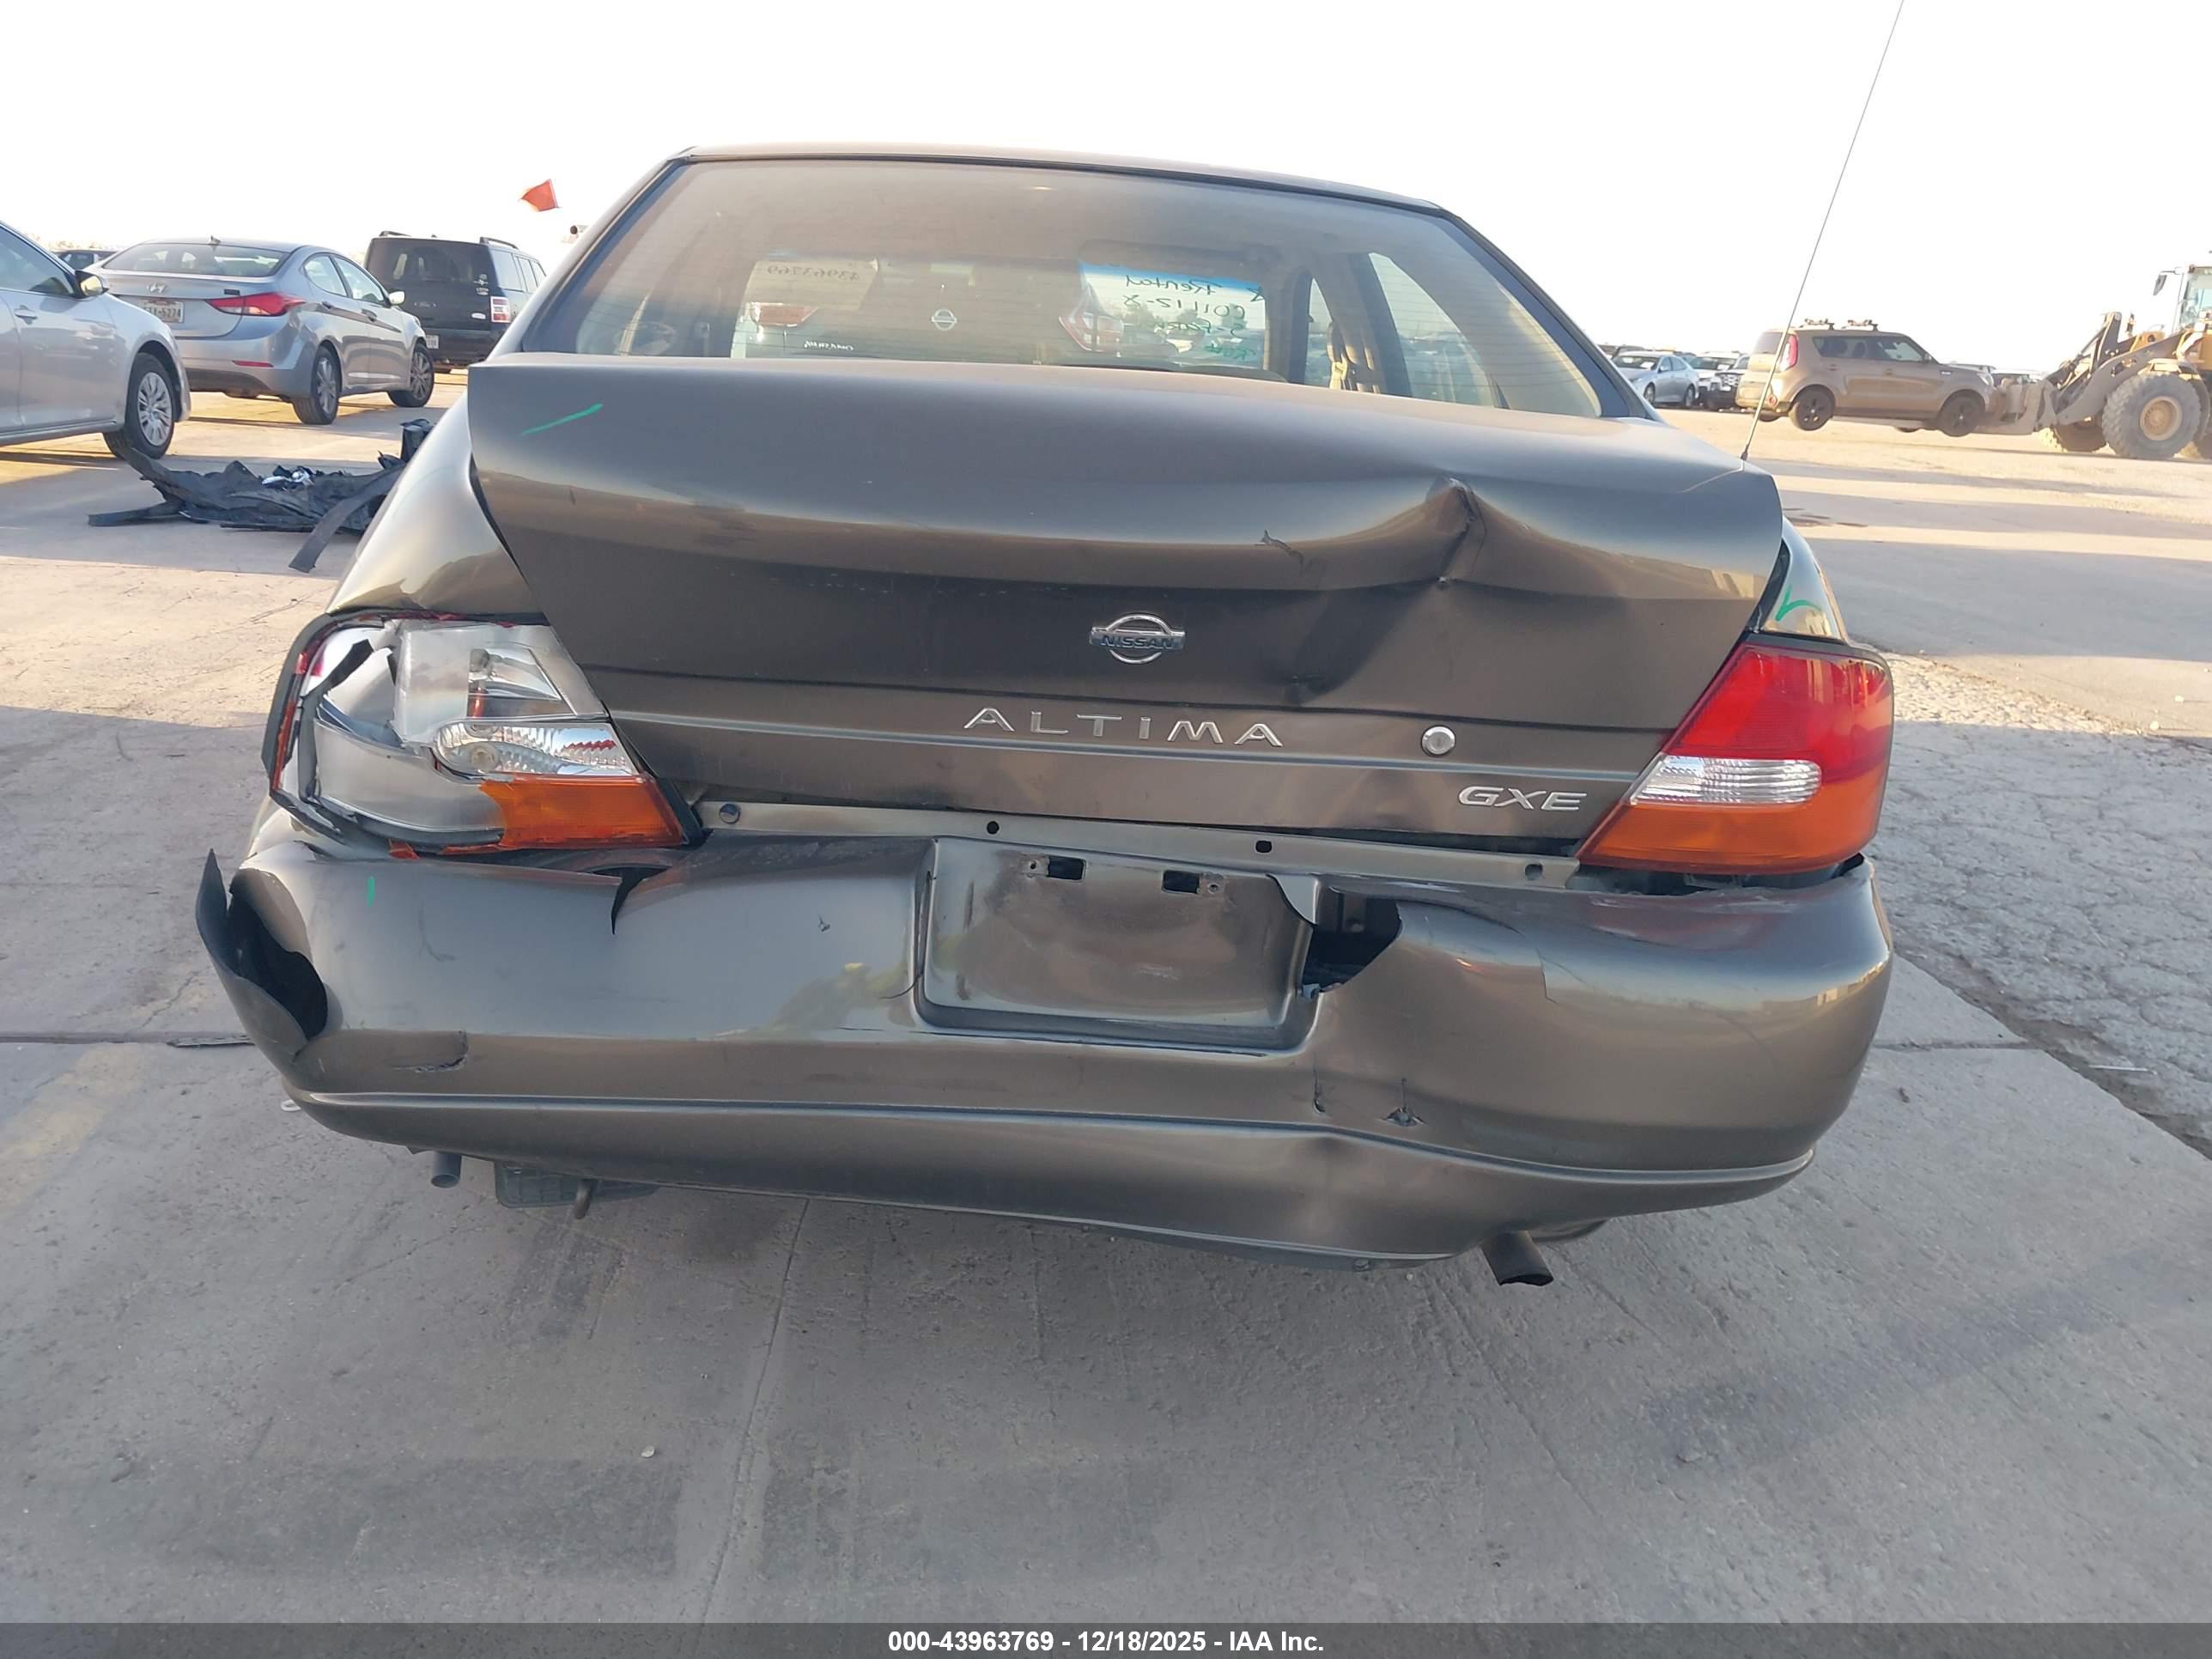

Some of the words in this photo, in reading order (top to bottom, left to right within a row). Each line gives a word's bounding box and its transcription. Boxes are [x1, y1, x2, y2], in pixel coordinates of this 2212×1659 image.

[1100, 635, 1175, 649] NISSAN
[963, 707, 1284, 747] ALTIMA
[1458, 786, 1588, 811] GXE
